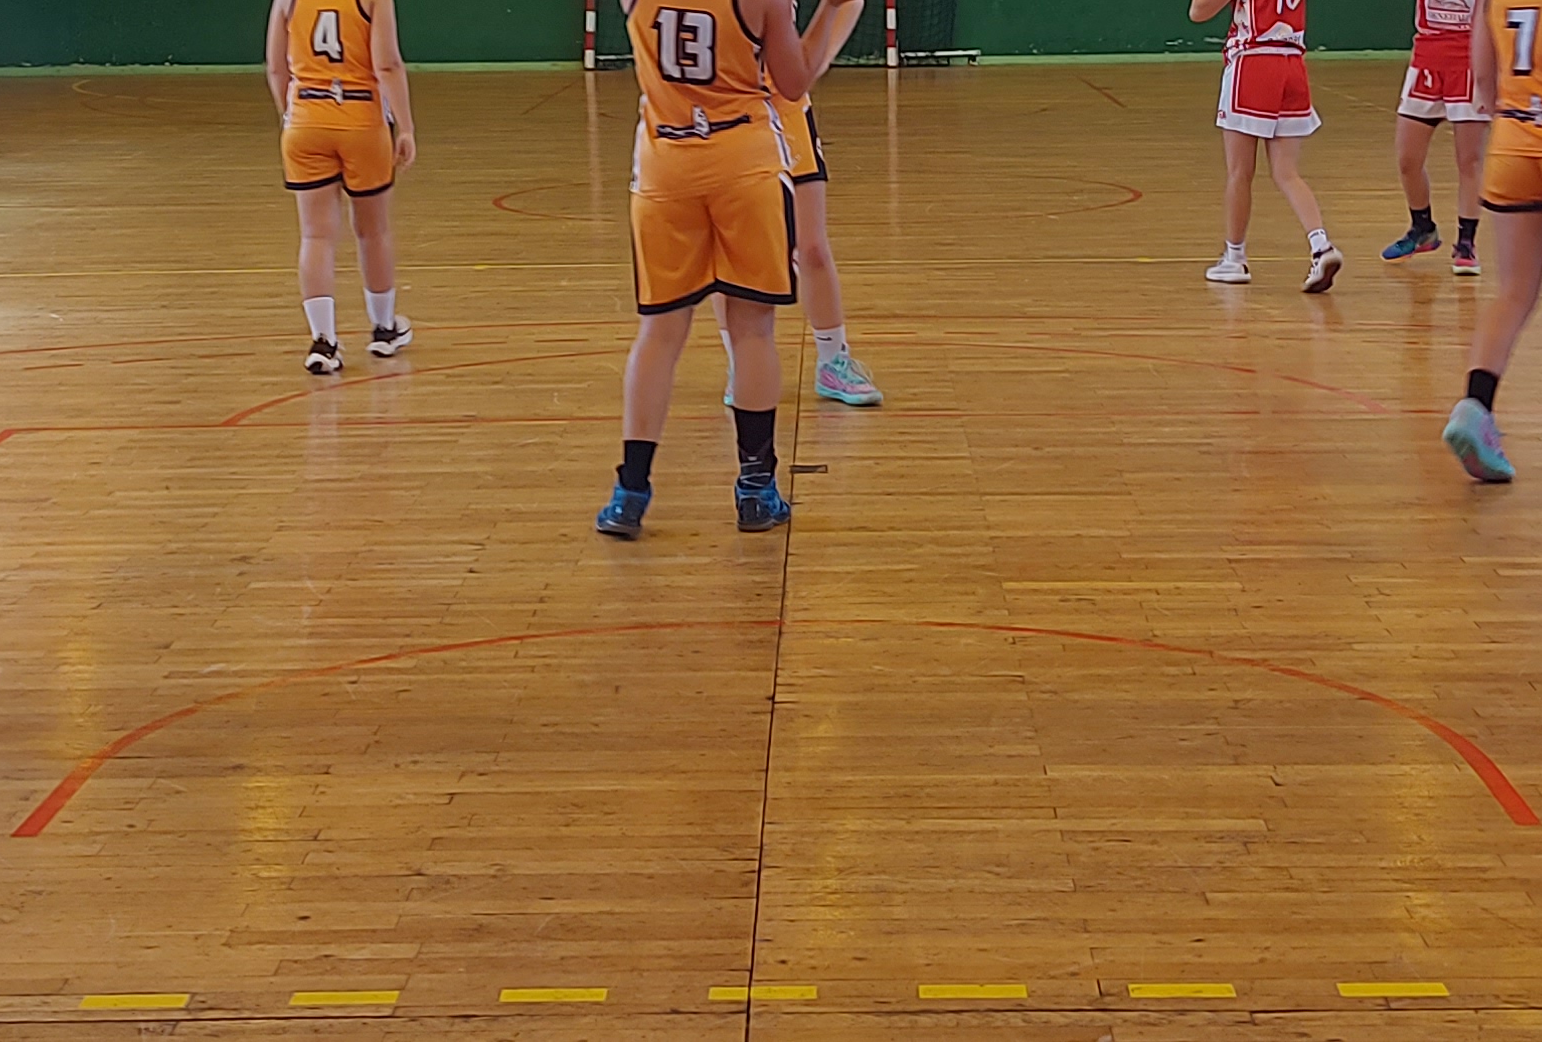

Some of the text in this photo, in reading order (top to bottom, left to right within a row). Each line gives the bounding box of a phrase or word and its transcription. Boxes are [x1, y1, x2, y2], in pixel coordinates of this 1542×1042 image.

[311, 10, 342, 61] 4
[655, 8, 715, 83] 13
[1506, 8, 1540, 76] 7
